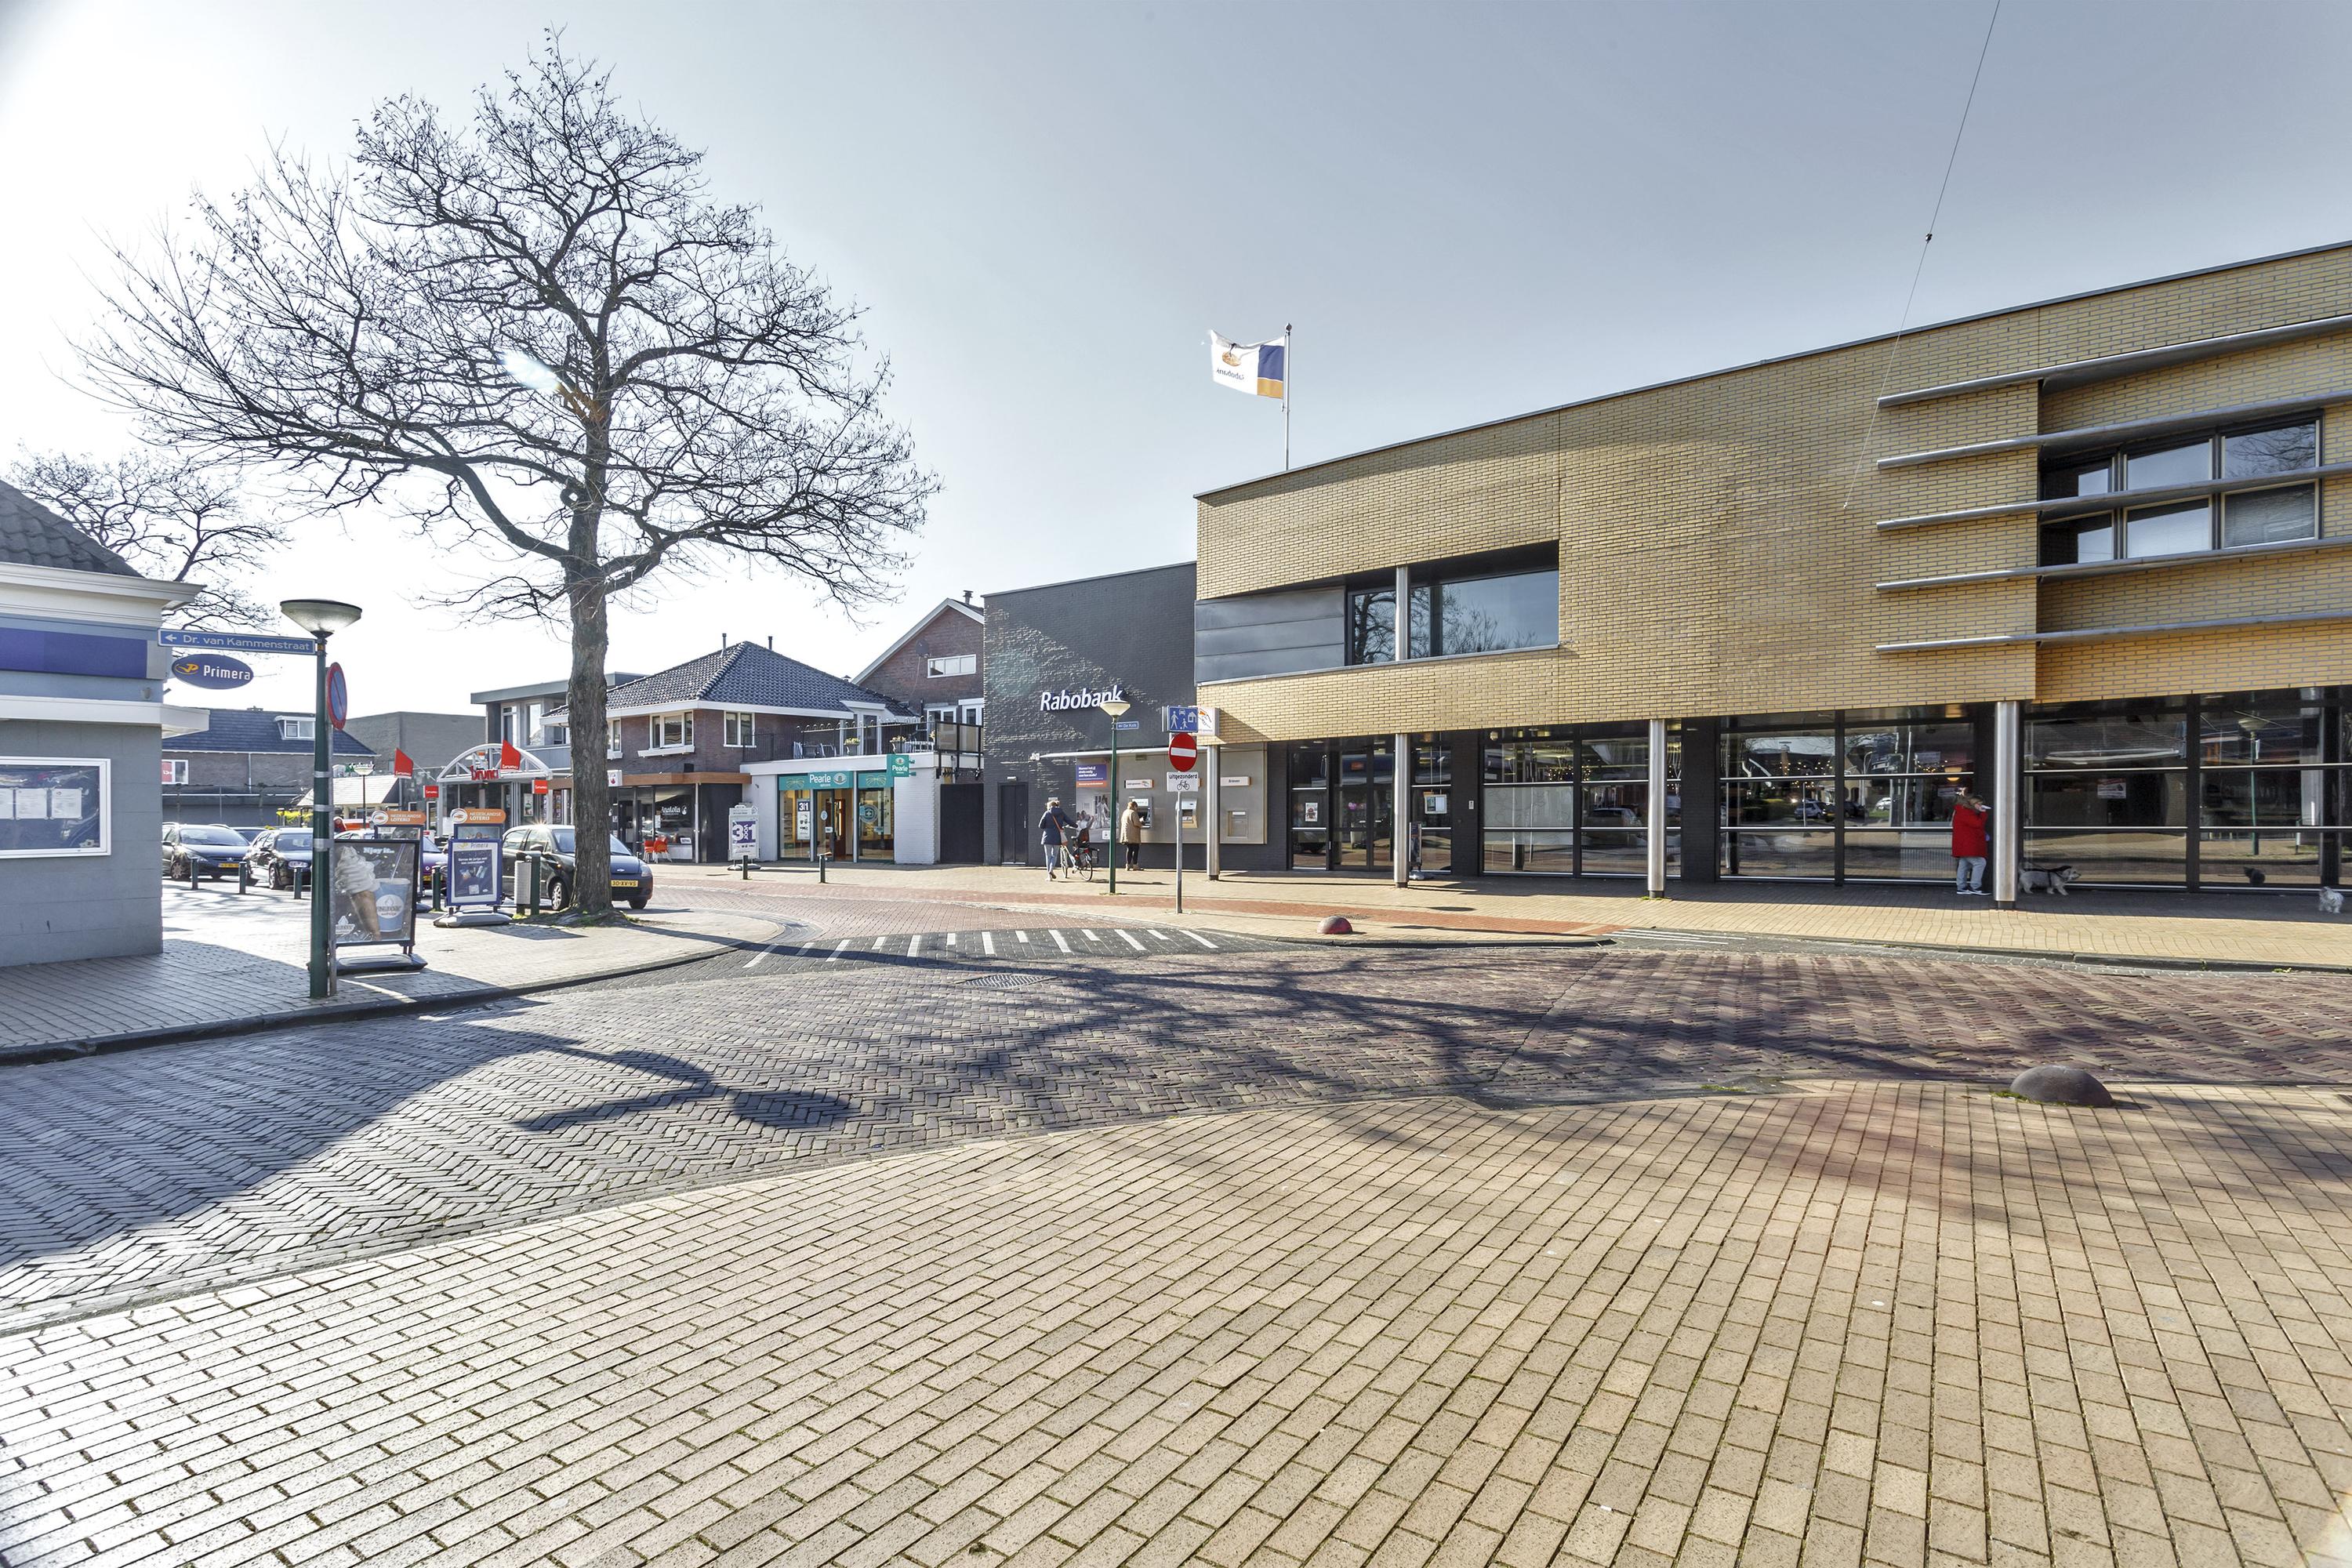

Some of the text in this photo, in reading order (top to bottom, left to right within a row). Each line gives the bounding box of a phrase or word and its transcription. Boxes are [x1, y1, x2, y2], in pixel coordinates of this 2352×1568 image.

[183, 634, 200, 644] Dr.
[227, 637, 310, 651] Kammenstraat
[203, 665, 251, 681] Primera
[1040, 684, 1123, 711] Rabobank
[809, 774, 831, 784] Pearle
[731, 824, 744, 840] 3
